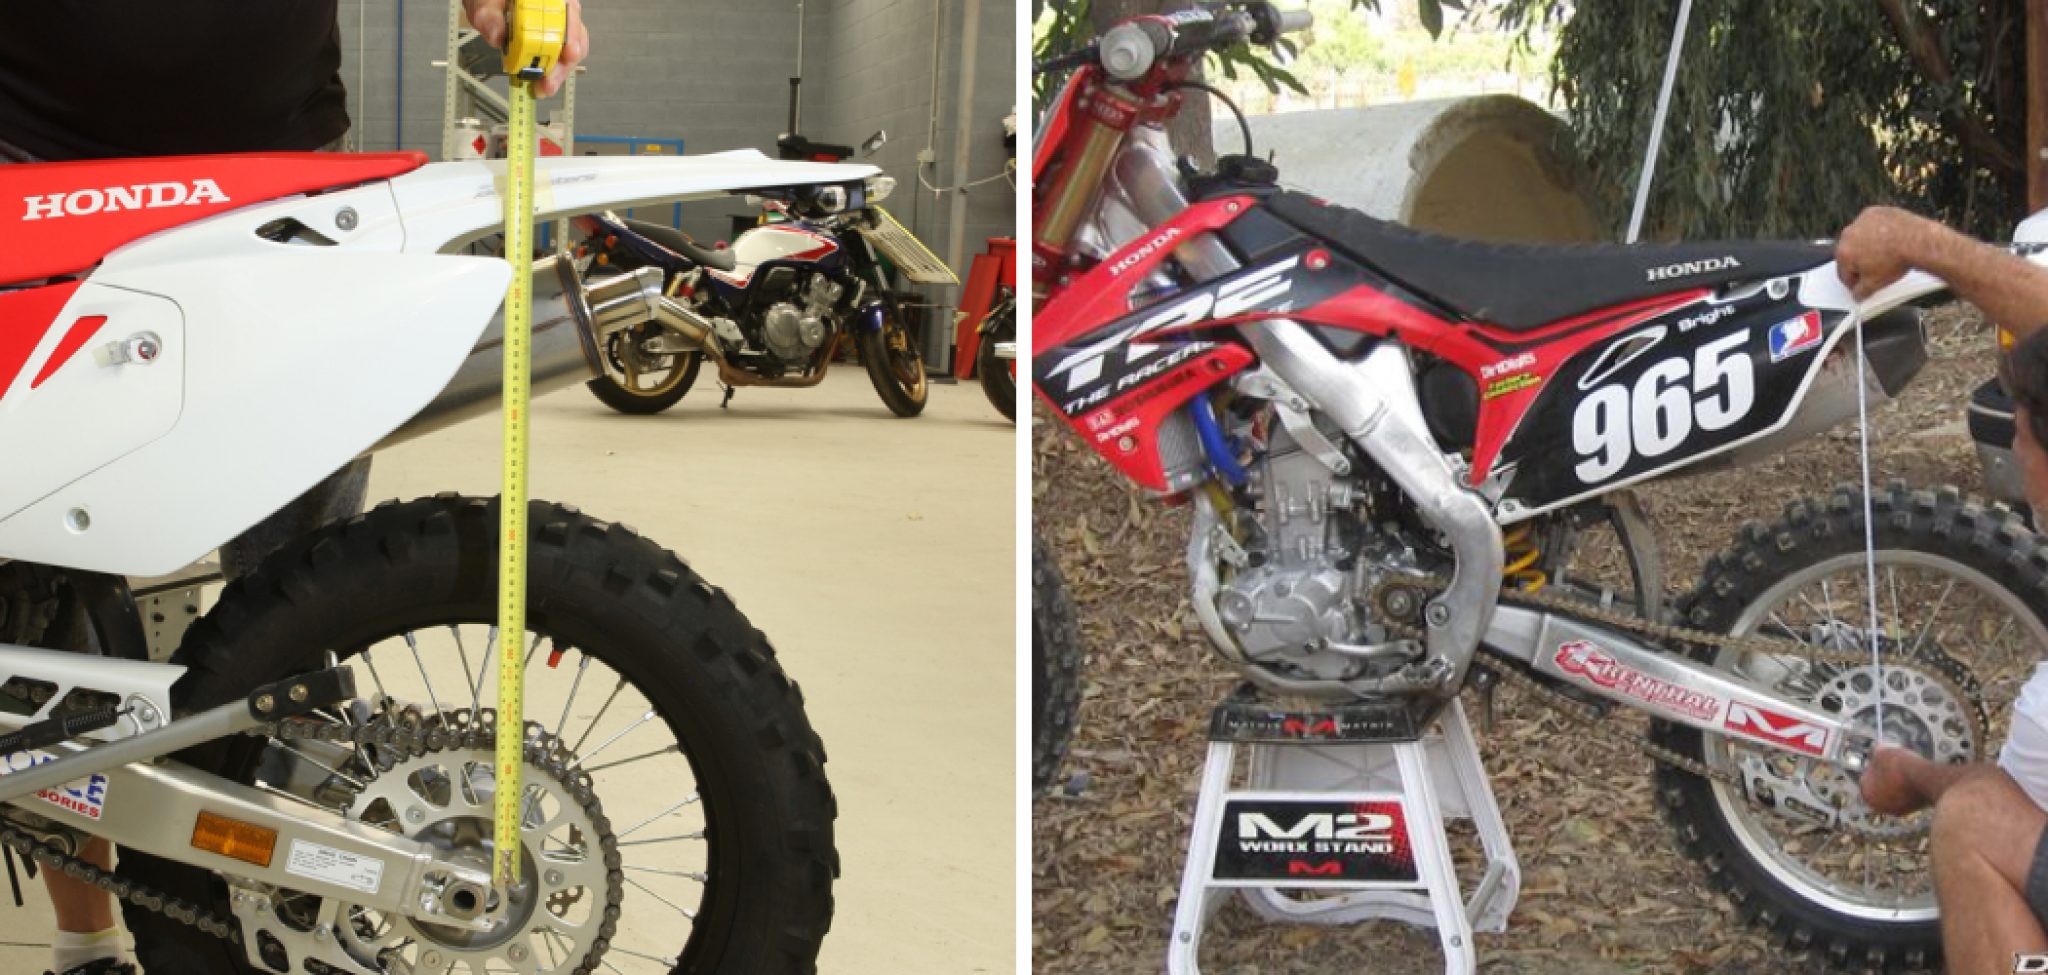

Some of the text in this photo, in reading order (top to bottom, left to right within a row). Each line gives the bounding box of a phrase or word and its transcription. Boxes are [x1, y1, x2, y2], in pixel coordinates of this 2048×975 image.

[22, 178, 231, 221] HONDA
[1110, 228, 1180, 275] HONDA
[1647, 256, 1742, 282] HONDA
[1677, 304, 1736, 333] Bright
[1063, 384, 1111, 415] THE
[1573, 328, 1755, 484] 965
[1238, 812, 1393, 839] M2
[1239, 842, 1393, 854] WORX STAND
